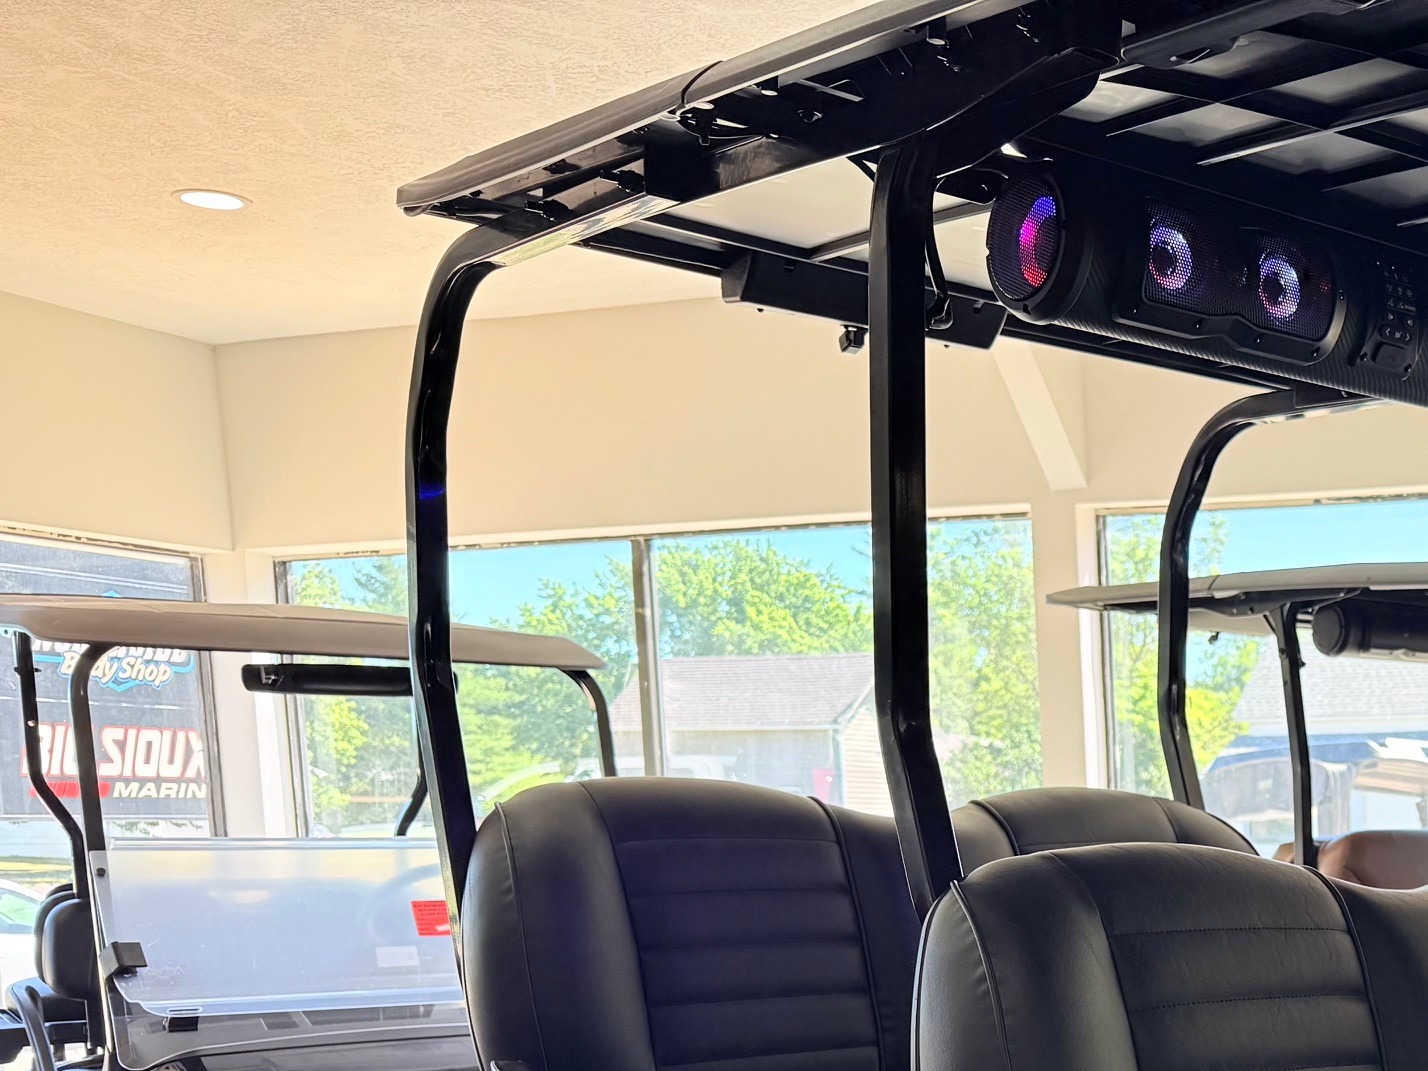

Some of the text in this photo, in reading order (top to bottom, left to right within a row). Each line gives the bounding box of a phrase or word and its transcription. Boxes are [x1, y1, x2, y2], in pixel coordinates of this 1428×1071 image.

[60, 651, 118, 684] Bdy
[118, 657, 171, 687] Shop
[98, 725, 205, 779] SIOUX
[113, 781, 207, 798] MARIN
